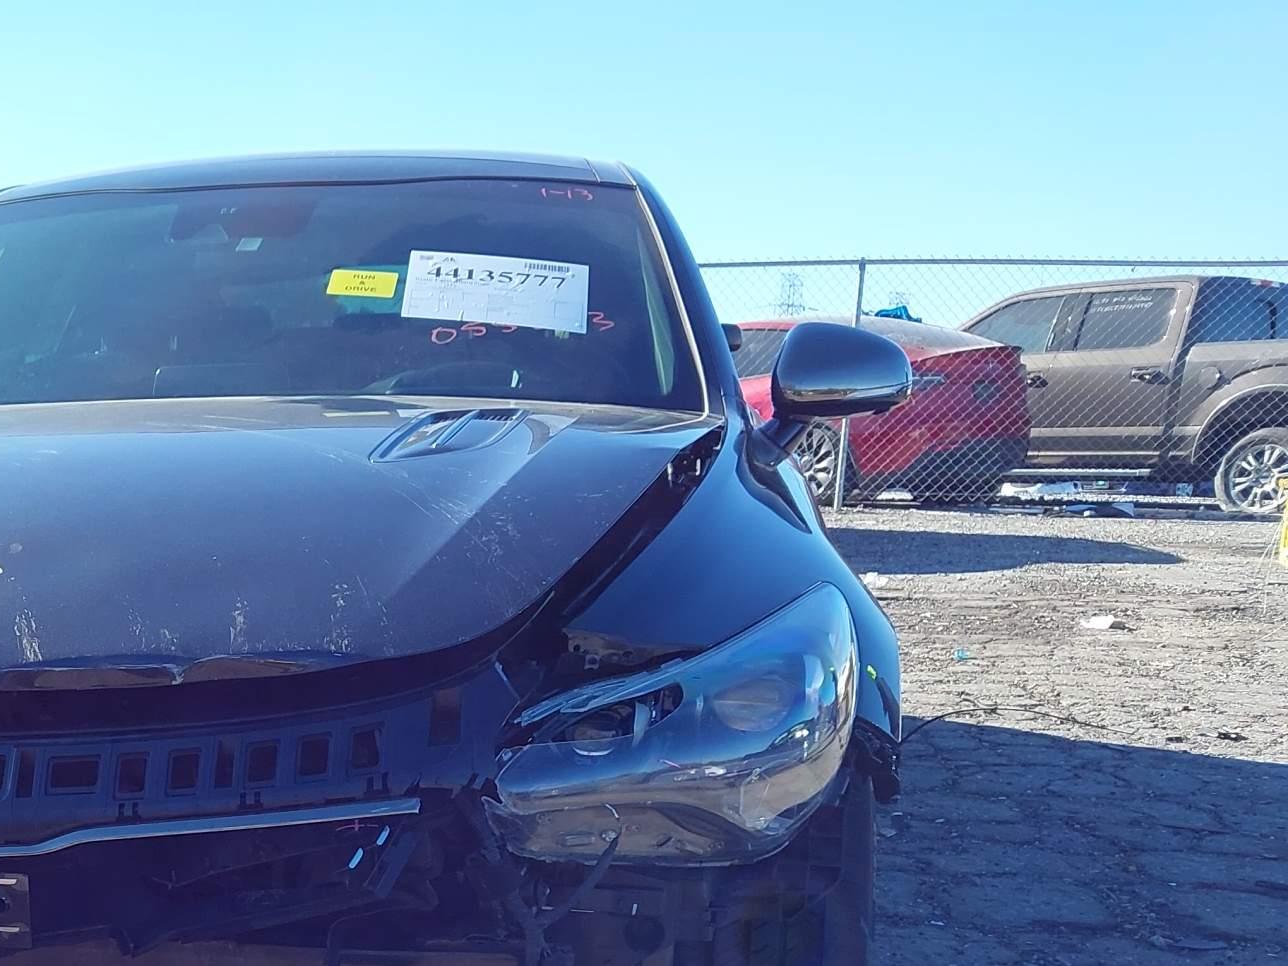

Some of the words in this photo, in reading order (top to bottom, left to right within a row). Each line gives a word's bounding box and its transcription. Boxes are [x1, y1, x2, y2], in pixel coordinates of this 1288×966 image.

[540, 186, 593, 201] 1-13
[353, 273, 376, 281] RUN
[426, 264, 567, 290] 44135777
[344, 285, 377, 293] DRIVE
